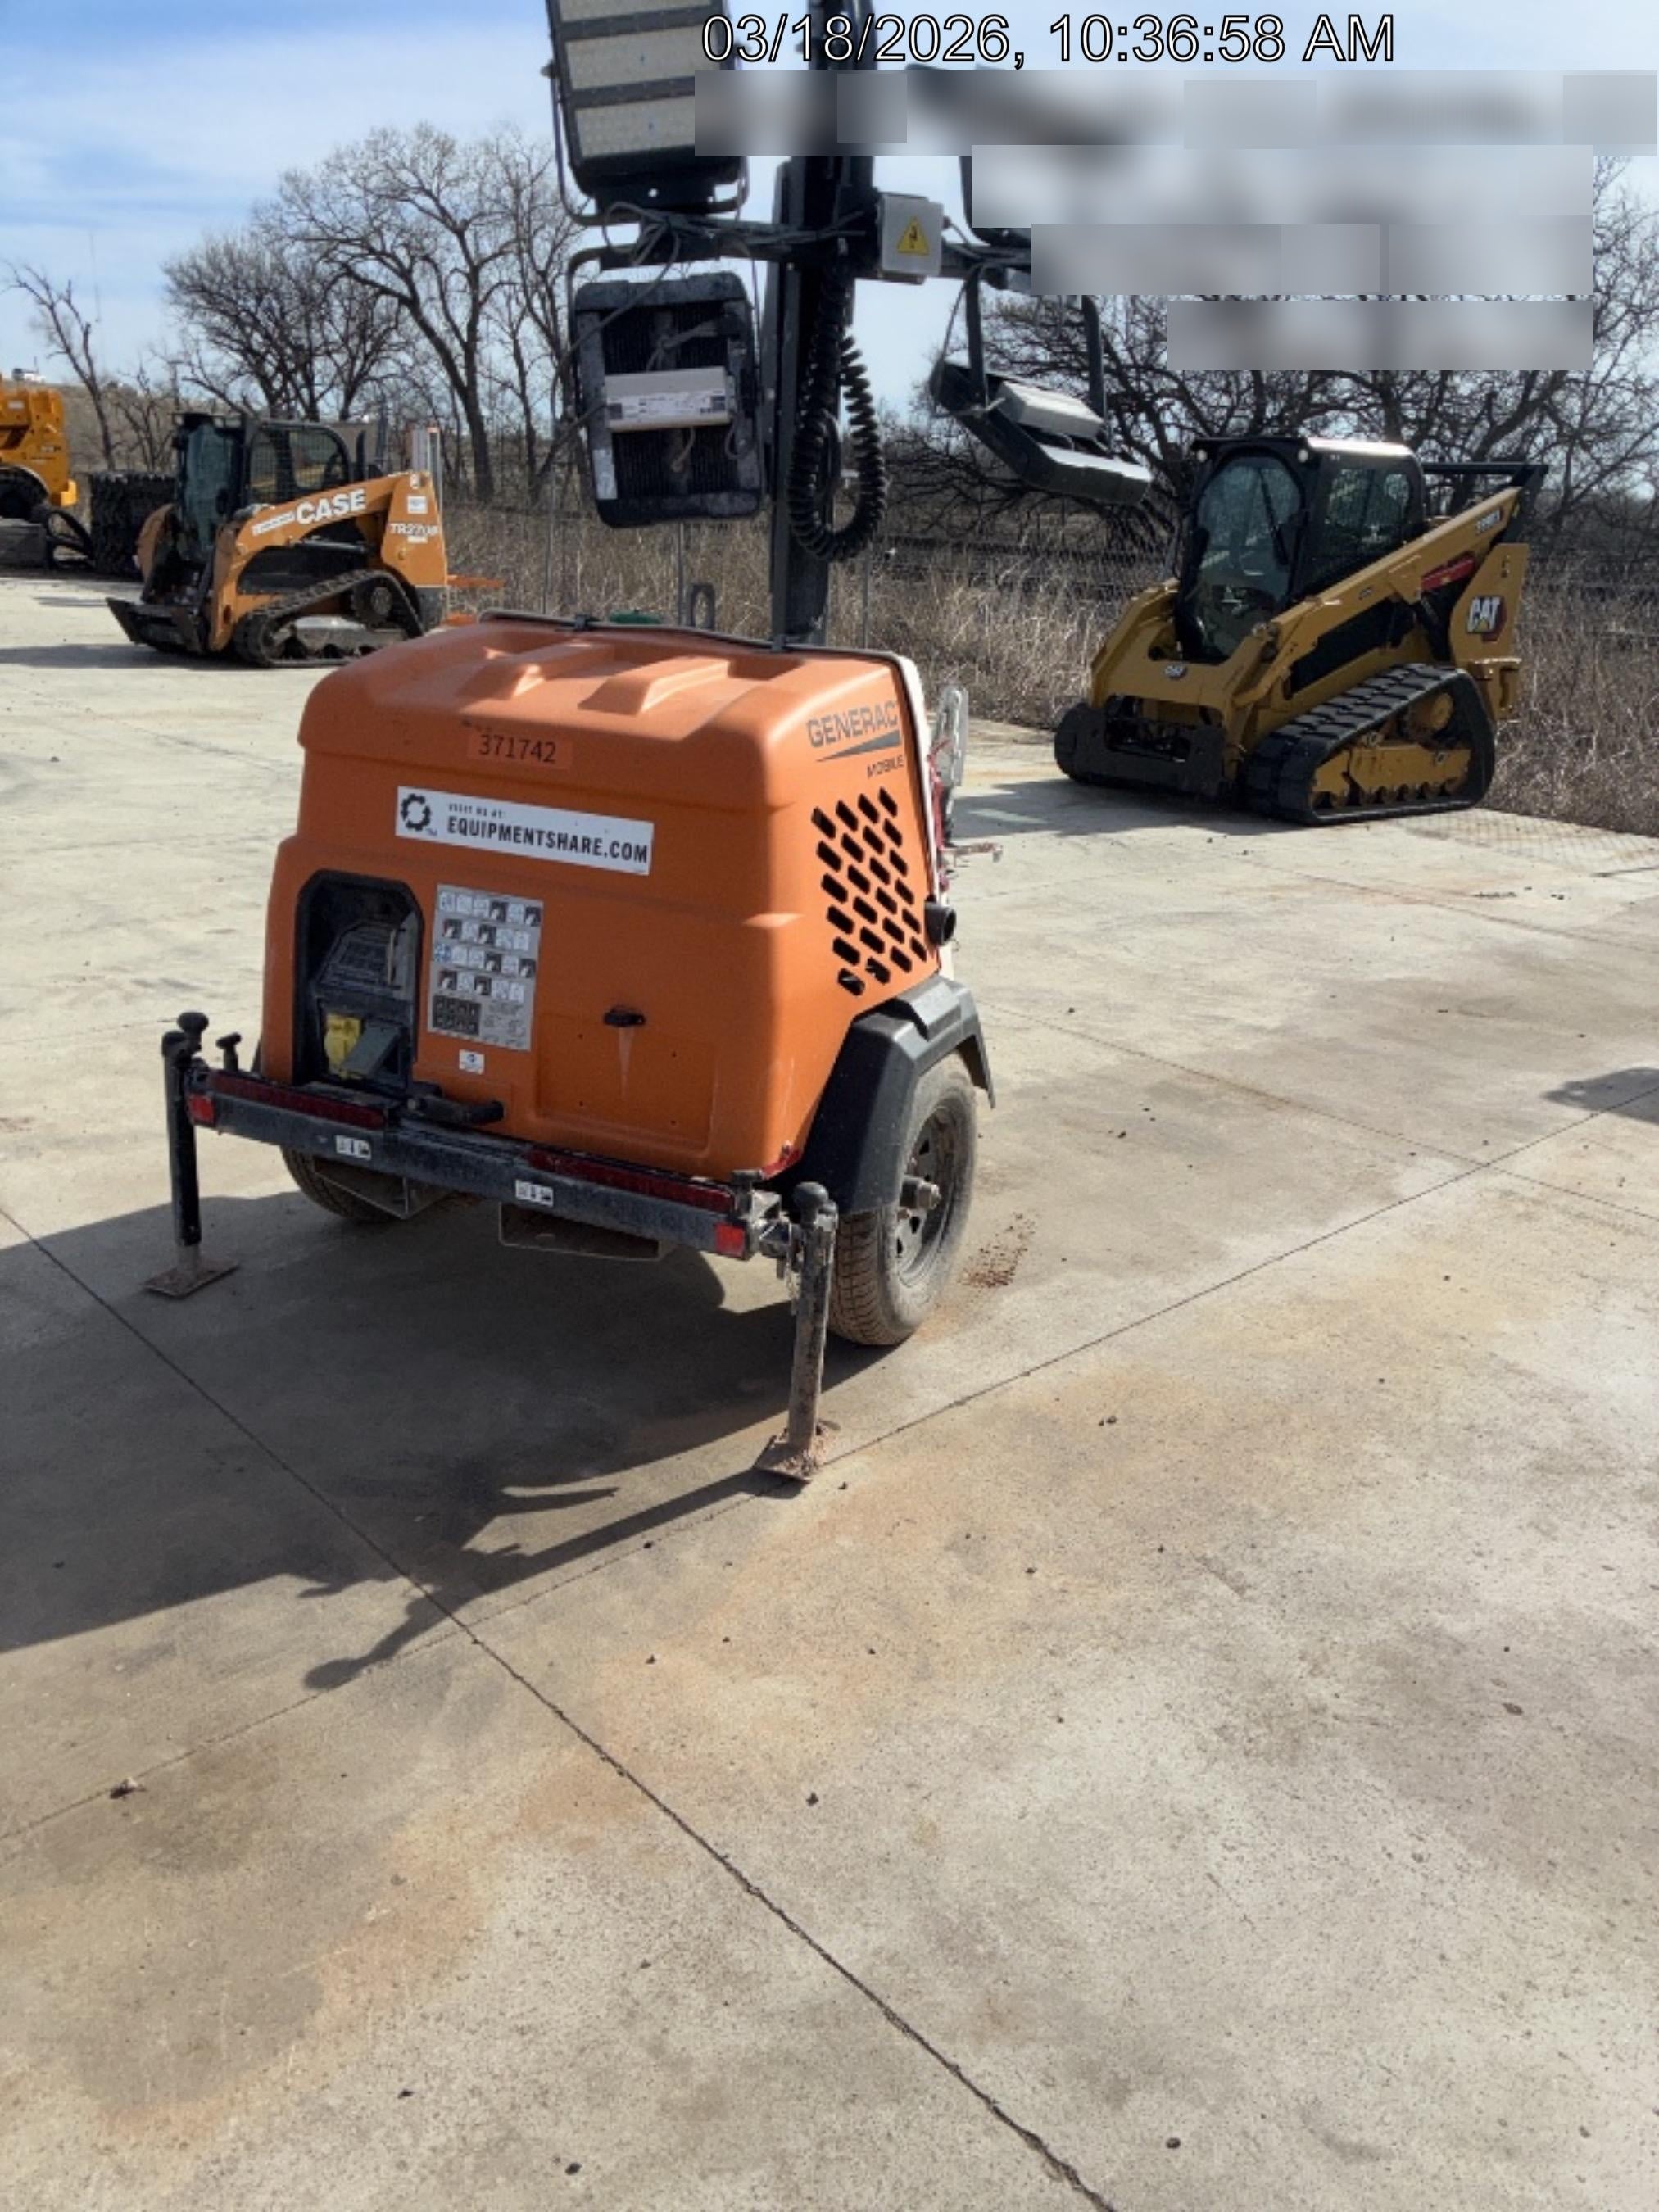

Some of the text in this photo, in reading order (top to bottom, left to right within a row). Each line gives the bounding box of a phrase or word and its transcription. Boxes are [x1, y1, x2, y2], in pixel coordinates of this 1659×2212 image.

[296, 488, 367, 524] CASE
[1466, 596, 1501, 634] CAT
[806, 700, 900, 748] GENERAC
[478, 733, 557, 764] 371742
[866, 755, 904, 778] MOBILE
[446, 815, 648, 864] EQUIPMENTSHARE.COM
